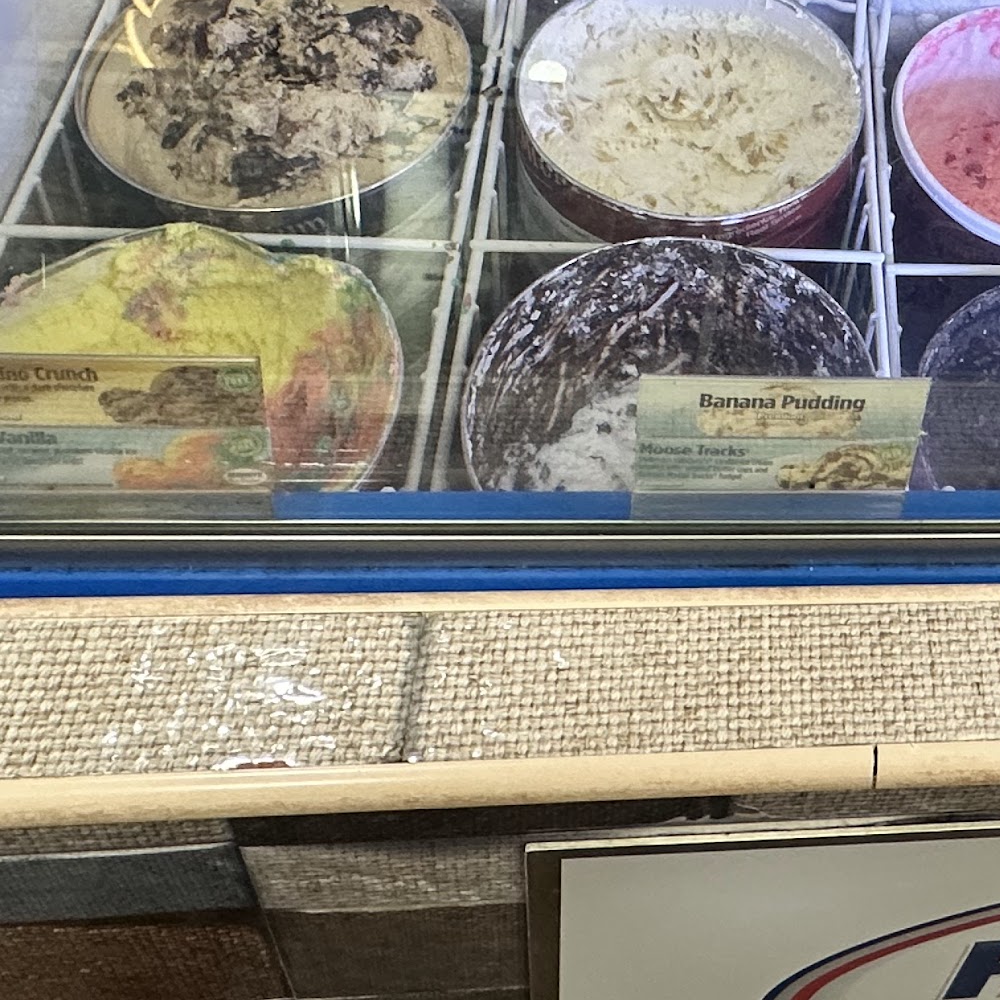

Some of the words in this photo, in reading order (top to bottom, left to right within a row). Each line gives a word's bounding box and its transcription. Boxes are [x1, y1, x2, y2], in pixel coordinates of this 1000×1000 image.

[34, 366, 99, 382] Crunch
[699, 393, 776, 409] Banana
[781, 394, 866, 413] Pudding
[639, 443, 693, 456] Moose
[696, 444, 747, 458] Tracks
